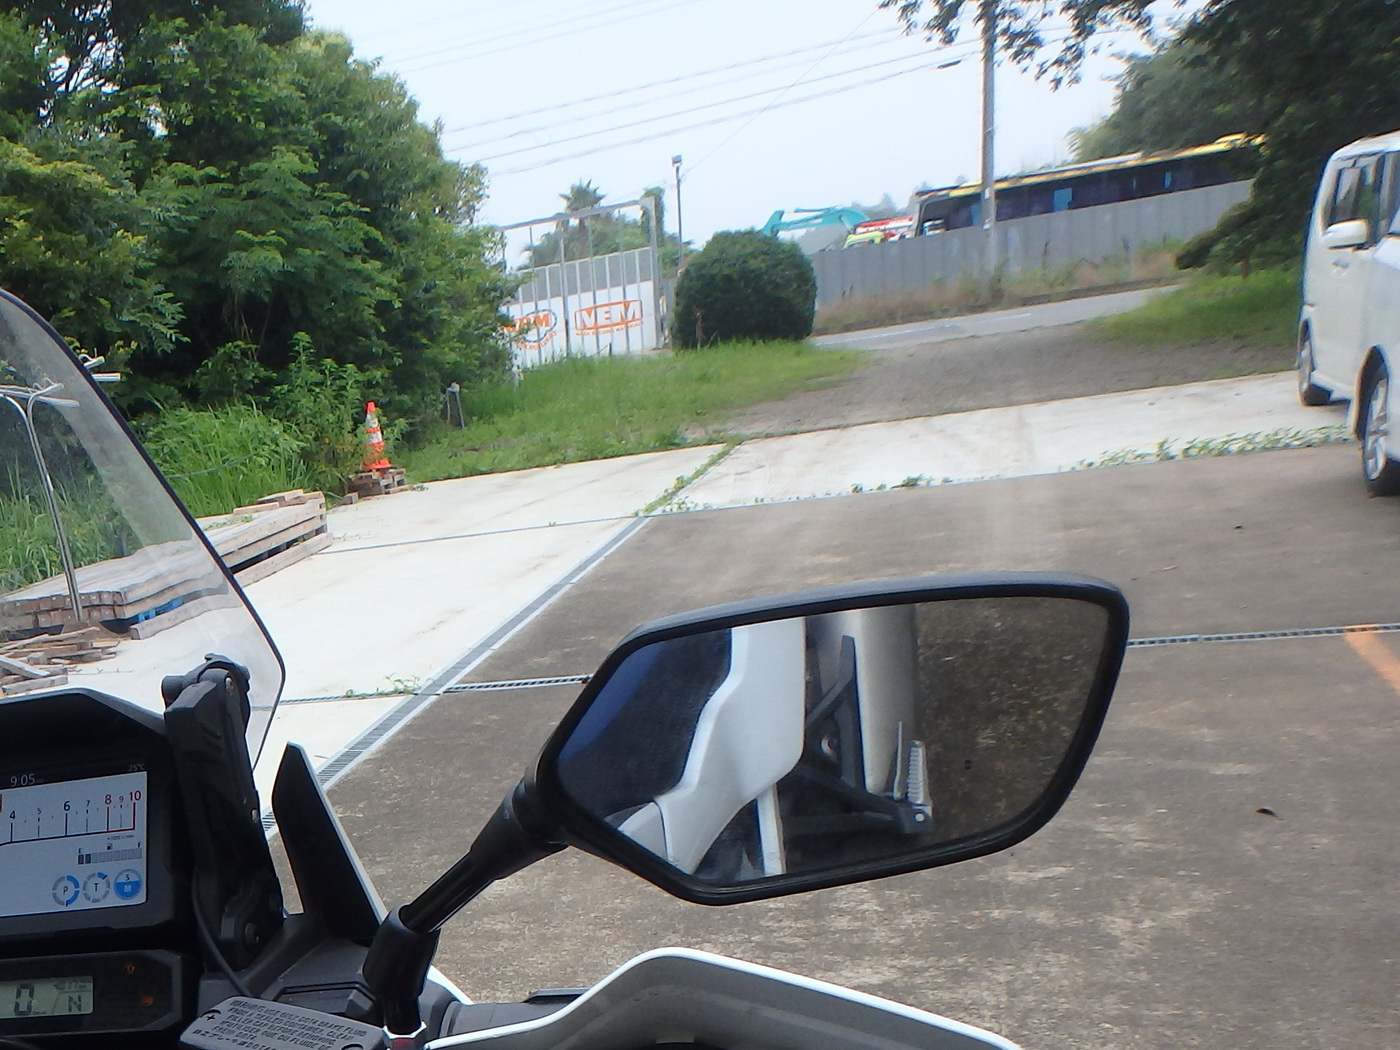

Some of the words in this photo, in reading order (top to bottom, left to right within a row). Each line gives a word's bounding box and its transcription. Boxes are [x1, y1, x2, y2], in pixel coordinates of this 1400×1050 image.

[10, 774, 36, 788] 9:05
[105, 794, 112, 805] 8
[129, 790, 141, 802] 10
[64, 801, 71, 811] 6
[9, 810, 16, 820] 4
[63, 886, 68, 895] P
[94, 883, 99, 892] T
[14, 983, 35, 1016] 0
[68, 995, 82, 1012] N
